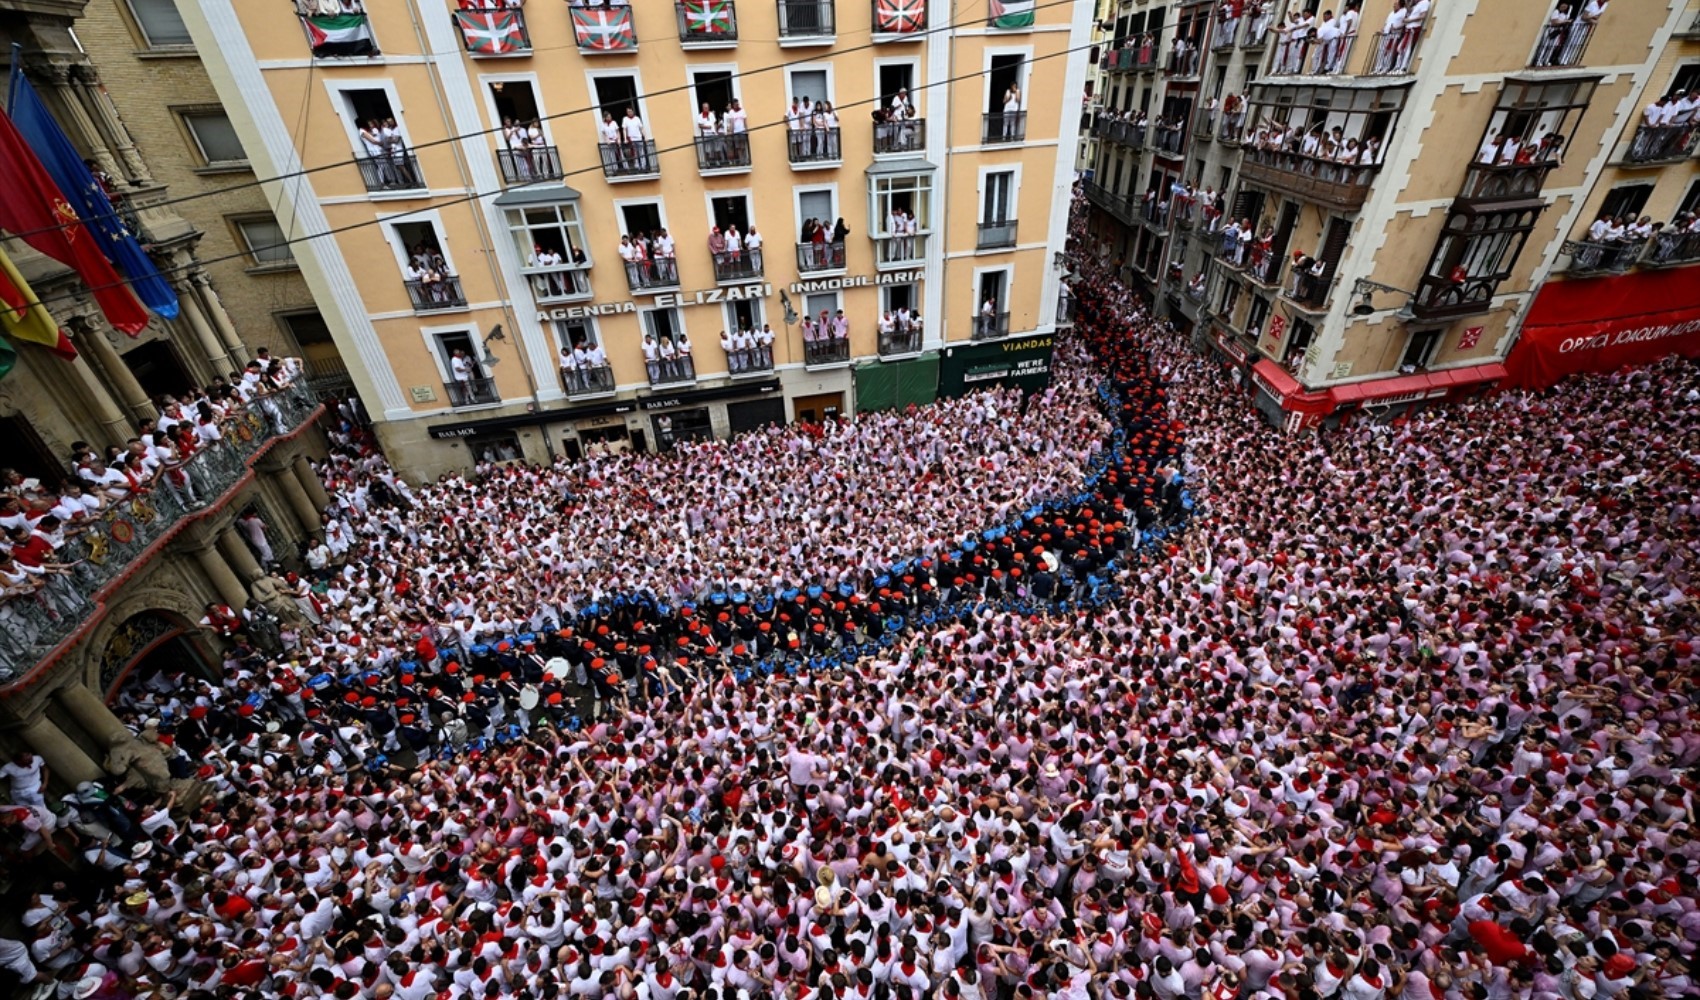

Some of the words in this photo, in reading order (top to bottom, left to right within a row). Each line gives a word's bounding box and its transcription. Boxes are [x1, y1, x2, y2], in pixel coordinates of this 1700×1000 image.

[536, 301, 637, 322] AGENCIA
[654, 283, 772, 308] ELIZARI
[790, 270, 926, 294] INMOBILIARIA
[1002, 338, 1053, 352] VIANDAS
[1010, 365, 1048, 377] FARMERS
[647, 401, 663, 409] BAR
[663, 399, 681, 407] MOL
[438, 430, 456, 439] BAR
[457, 427, 477, 437] MOL
